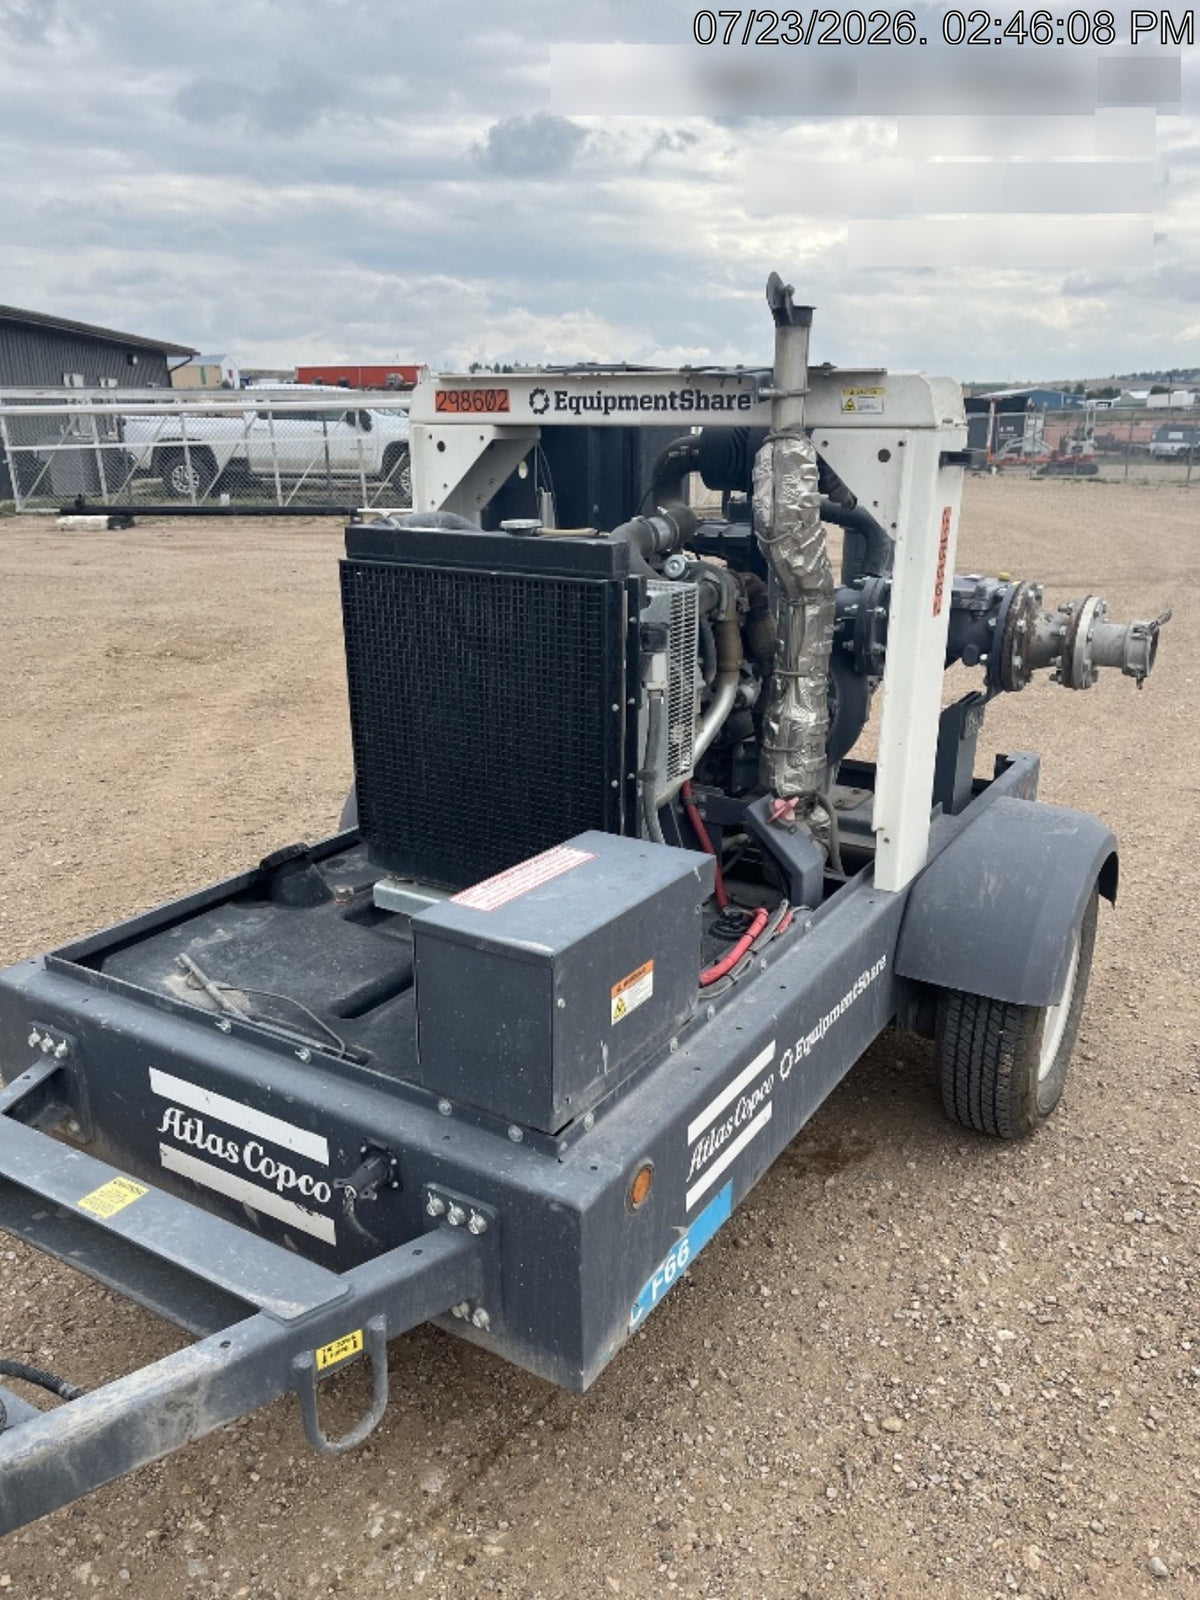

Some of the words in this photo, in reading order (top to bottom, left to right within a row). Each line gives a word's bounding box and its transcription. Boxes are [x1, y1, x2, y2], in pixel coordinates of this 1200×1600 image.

[436, 389, 510, 412] 298602
[554, 389, 751, 415] EquipmentShare
[794, 954, 887, 1064] EquipmentShare
[157, 1107, 240, 1164] Atlas
[243, 1141, 332, 1203] Copco
[686, 1114, 734, 1183] Atlas
[733, 1073, 775, 1130] Copco
